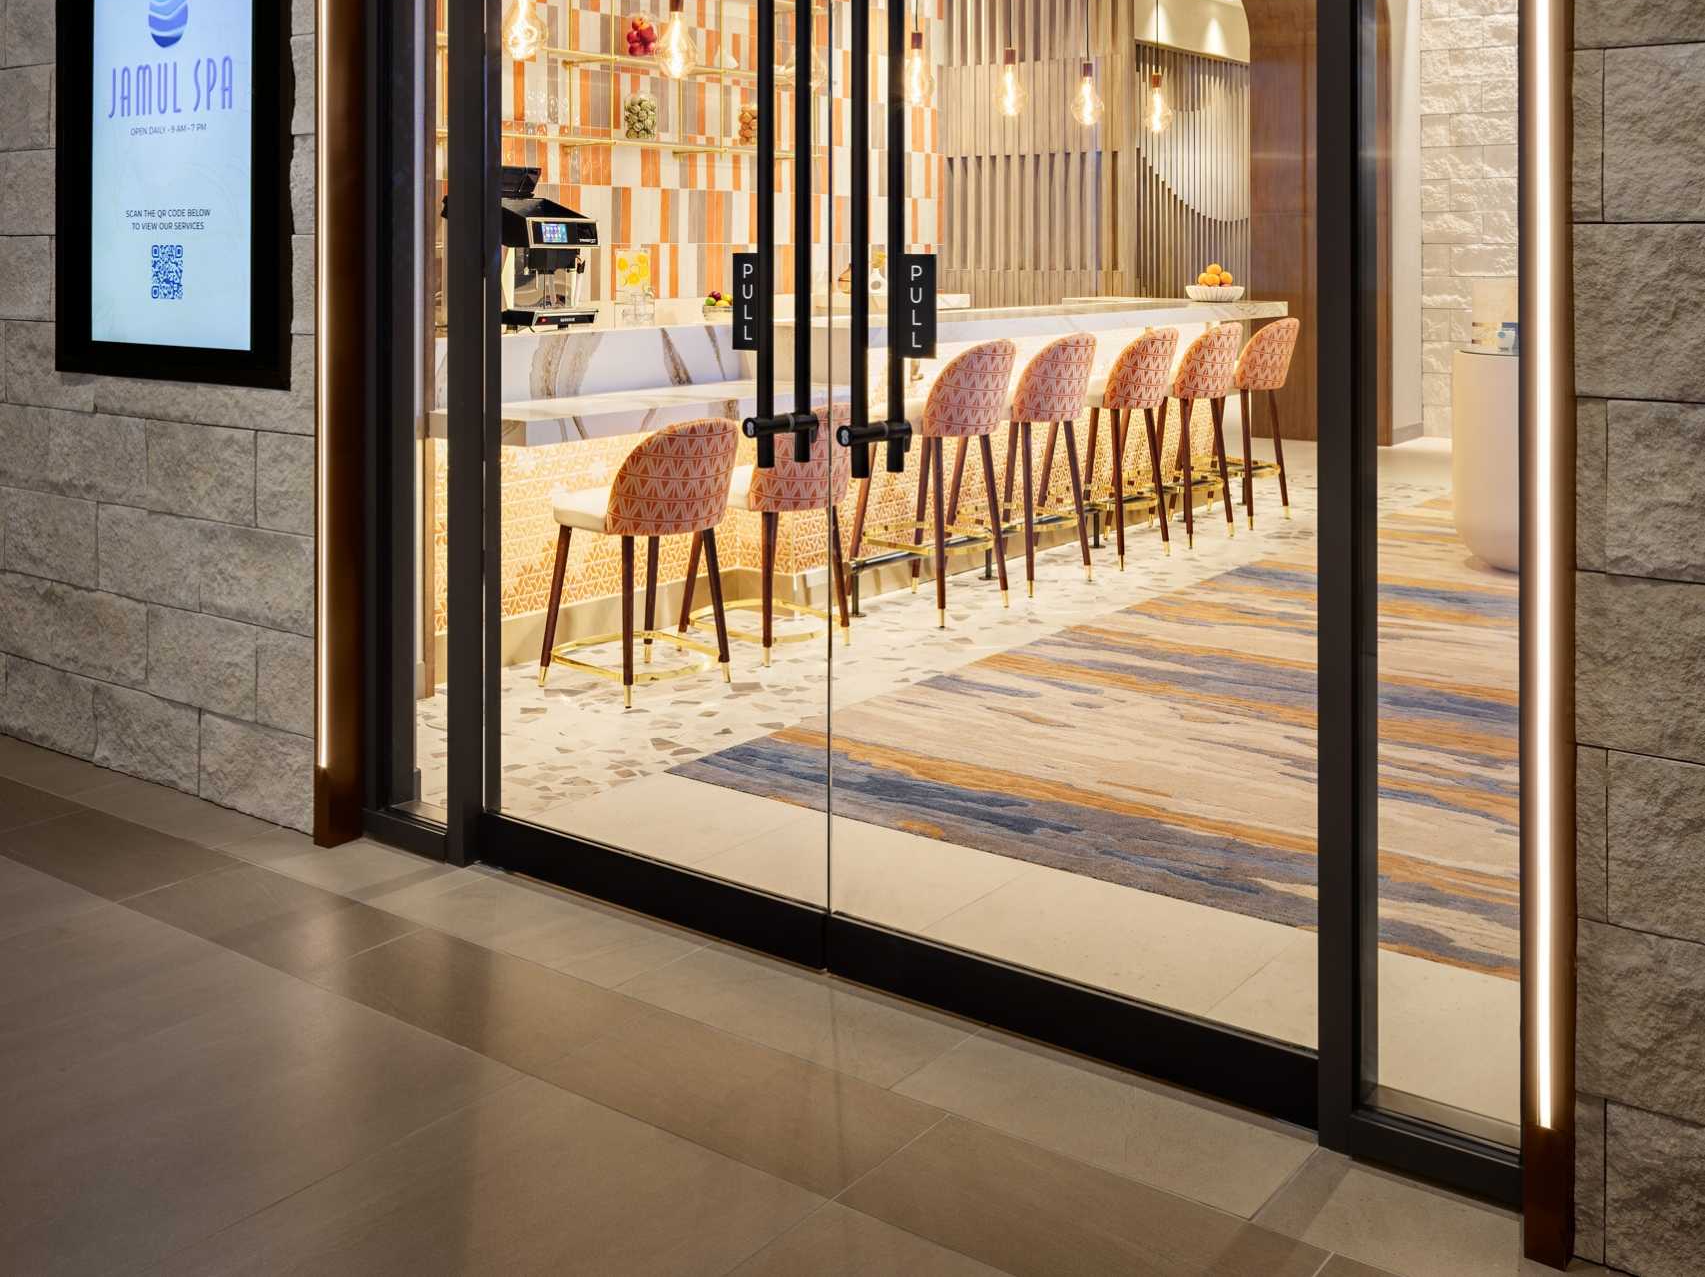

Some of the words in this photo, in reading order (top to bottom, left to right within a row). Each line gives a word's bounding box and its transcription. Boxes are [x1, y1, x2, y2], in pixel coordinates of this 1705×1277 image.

[108, 61, 182, 119] JAMUL
[193, 55, 233, 112] SPA
[130, 126, 147, 136] OPEN
[196, 123, 207, 131] PM
[126, 210, 142, 218] SCAN
[157, 210, 166, 218] QR
[168, 209, 185, 217] CODE
[174, 222, 204, 230] SERVICES
[742, 263, 754, 341] PULL
[910, 265, 923, 348] PULL
